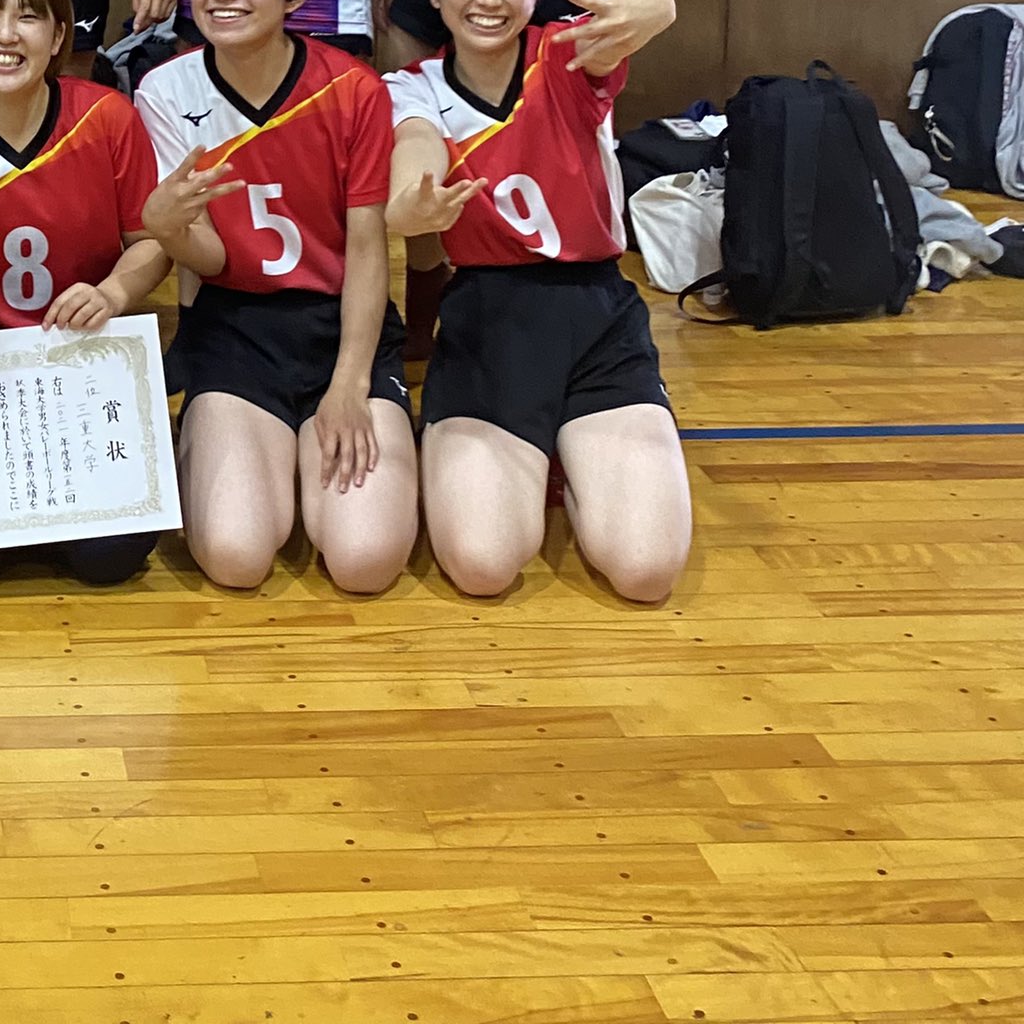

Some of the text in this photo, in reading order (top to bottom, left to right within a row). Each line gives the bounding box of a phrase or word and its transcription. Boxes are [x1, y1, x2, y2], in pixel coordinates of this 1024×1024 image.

[248, 183, 302, 276] 5
[493, 174, 562, 260] 9
[1, 225, 54, 312] 8
[84, 375, 101, 398] 二位
[76, 402, 99, 473] 三重大学
[102, 399, 129, 462] 賞状
